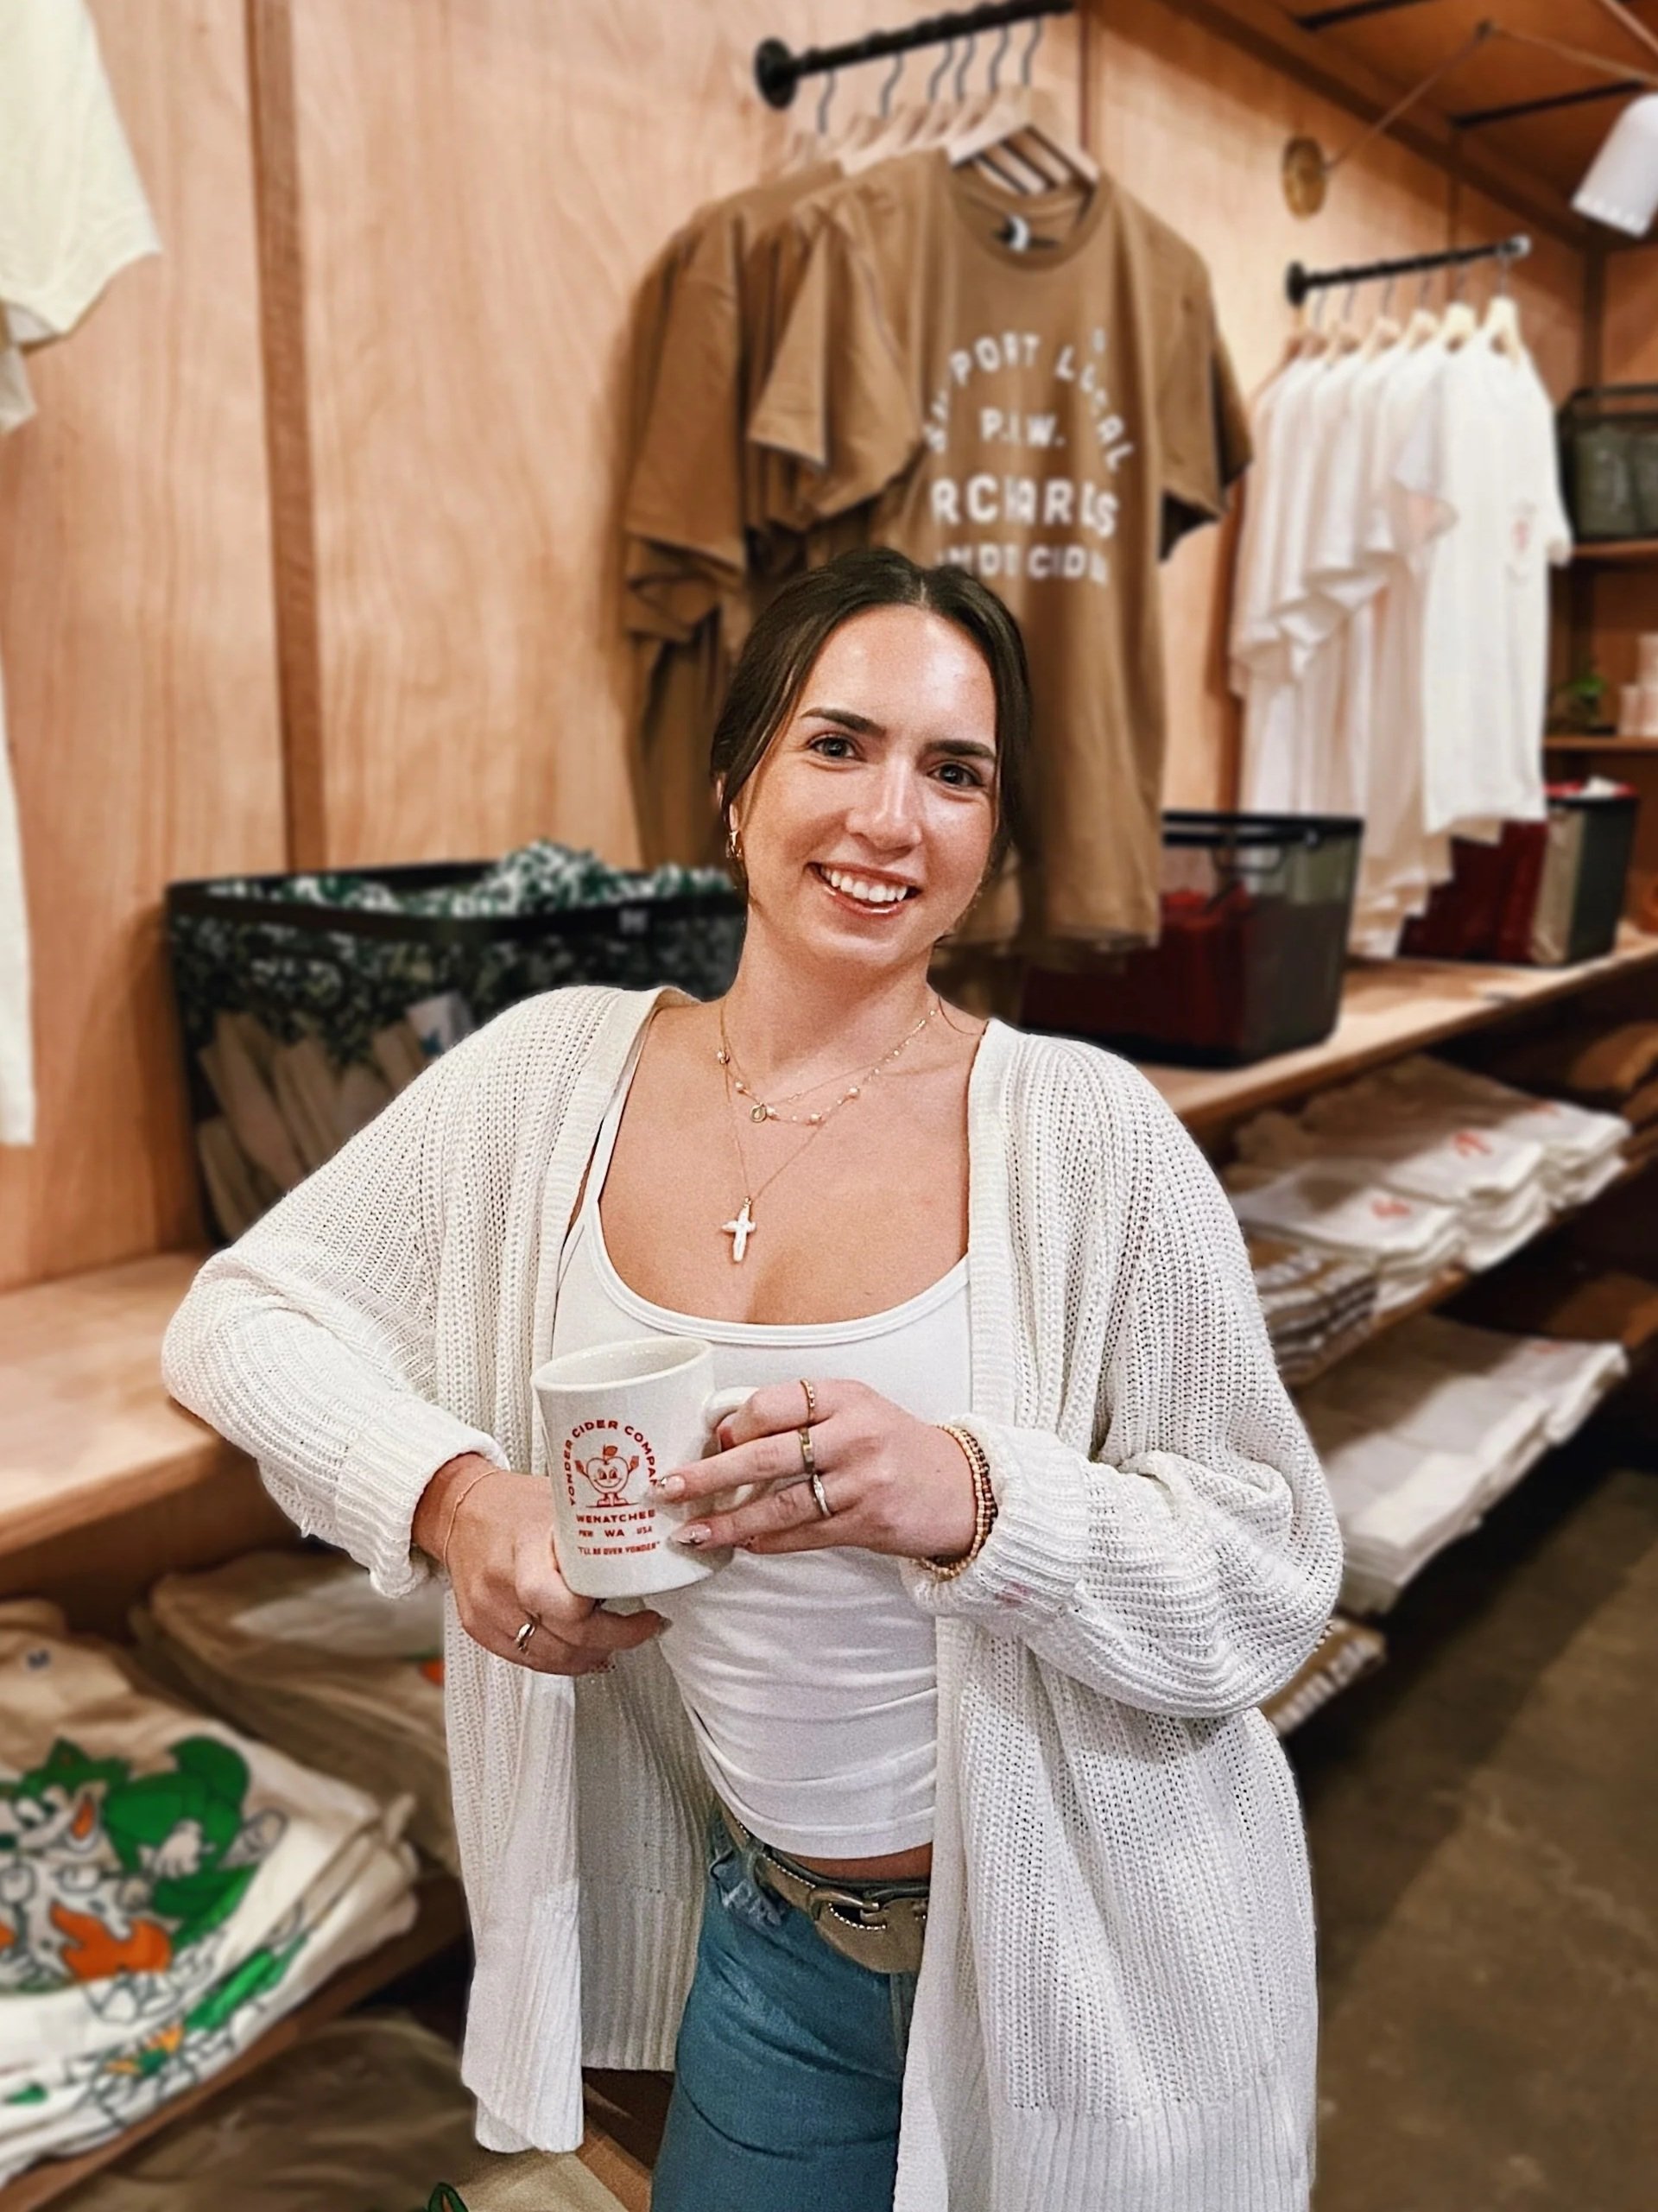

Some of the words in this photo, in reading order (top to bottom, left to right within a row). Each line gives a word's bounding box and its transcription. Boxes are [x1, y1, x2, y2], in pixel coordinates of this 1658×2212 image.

[564, 1439, 576, 1506] YONDER
[572, 1419, 618, 1438] CIDER
[624, 1425, 658, 1486] COMPA
[576, 1509, 655, 1524] WENATCHEE
[604, 1529, 625, 1537] WA
[636, 1525, 653, 1535] USA
[592, 1547, 602, 1556] BE
[603, 1547, 623, 1556] OVER
